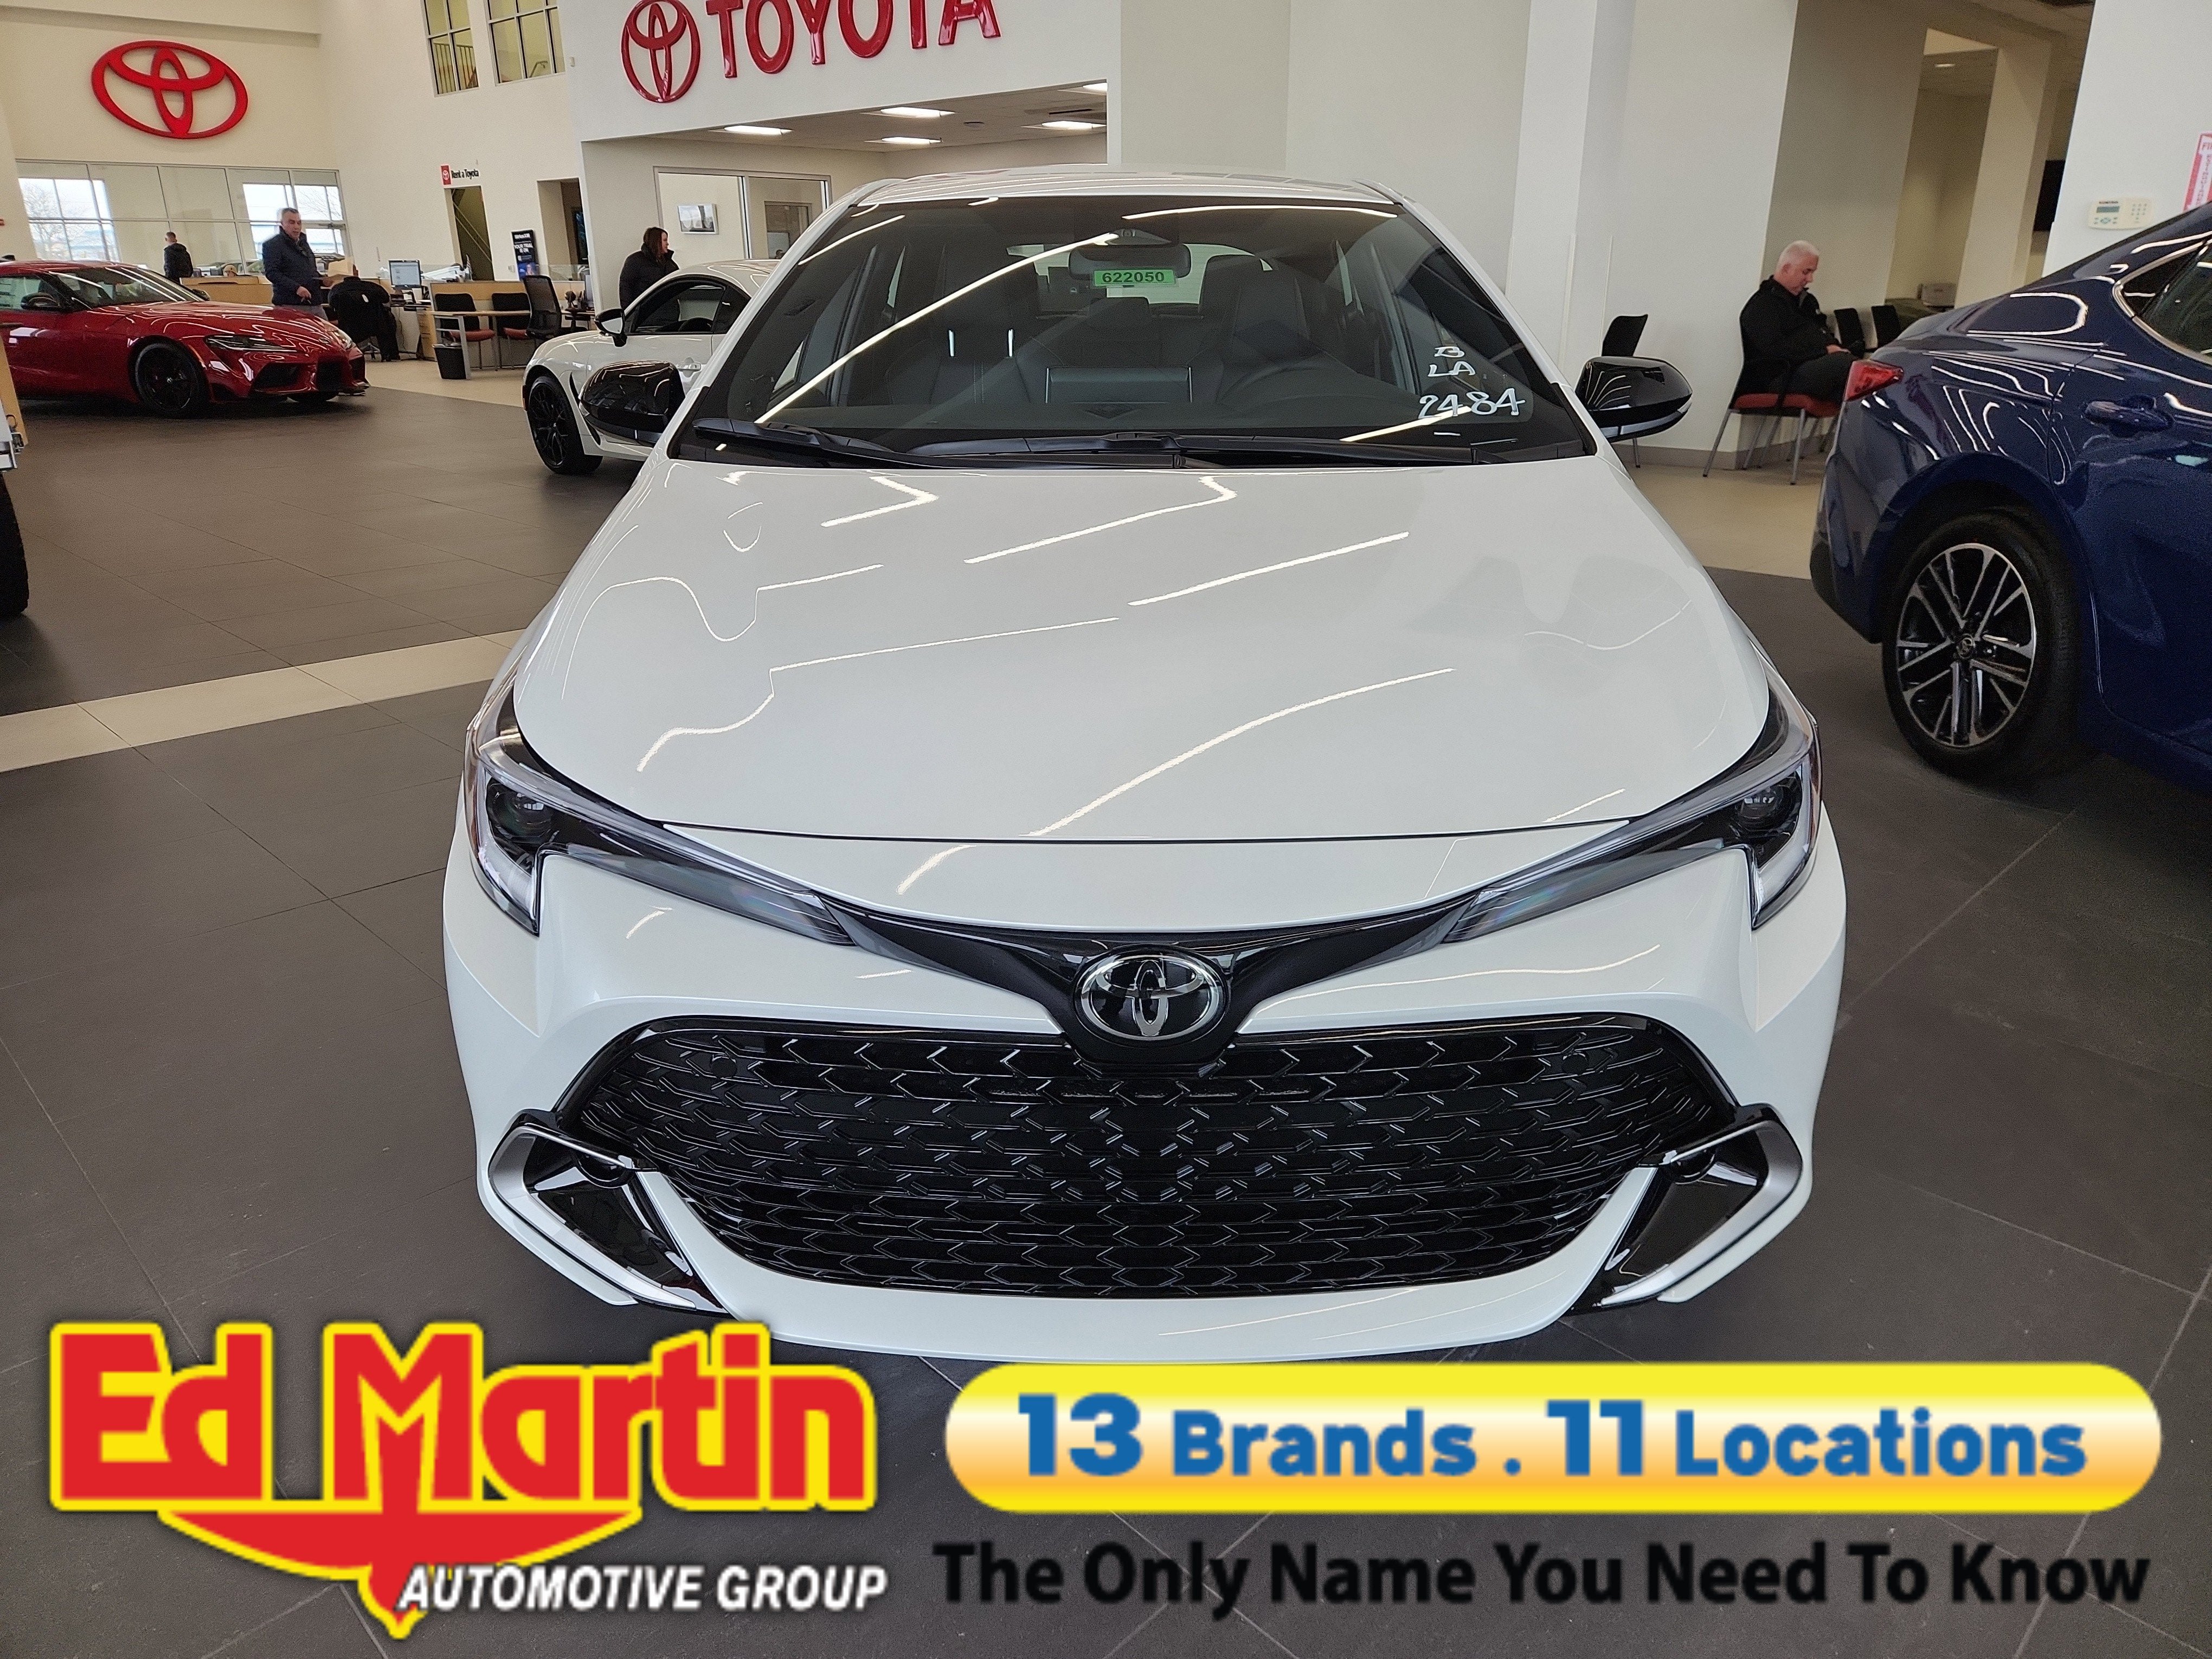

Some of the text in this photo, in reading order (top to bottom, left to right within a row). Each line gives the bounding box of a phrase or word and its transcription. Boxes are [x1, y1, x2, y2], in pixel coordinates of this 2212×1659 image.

[451, 170, 461, 179] Rent
[464, 169, 479, 179] Toyota
[1102, 272, 1165, 283] 622050
[1427, 361, 1476, 377] LA
[1418, 388, 1526, 419] 2484
